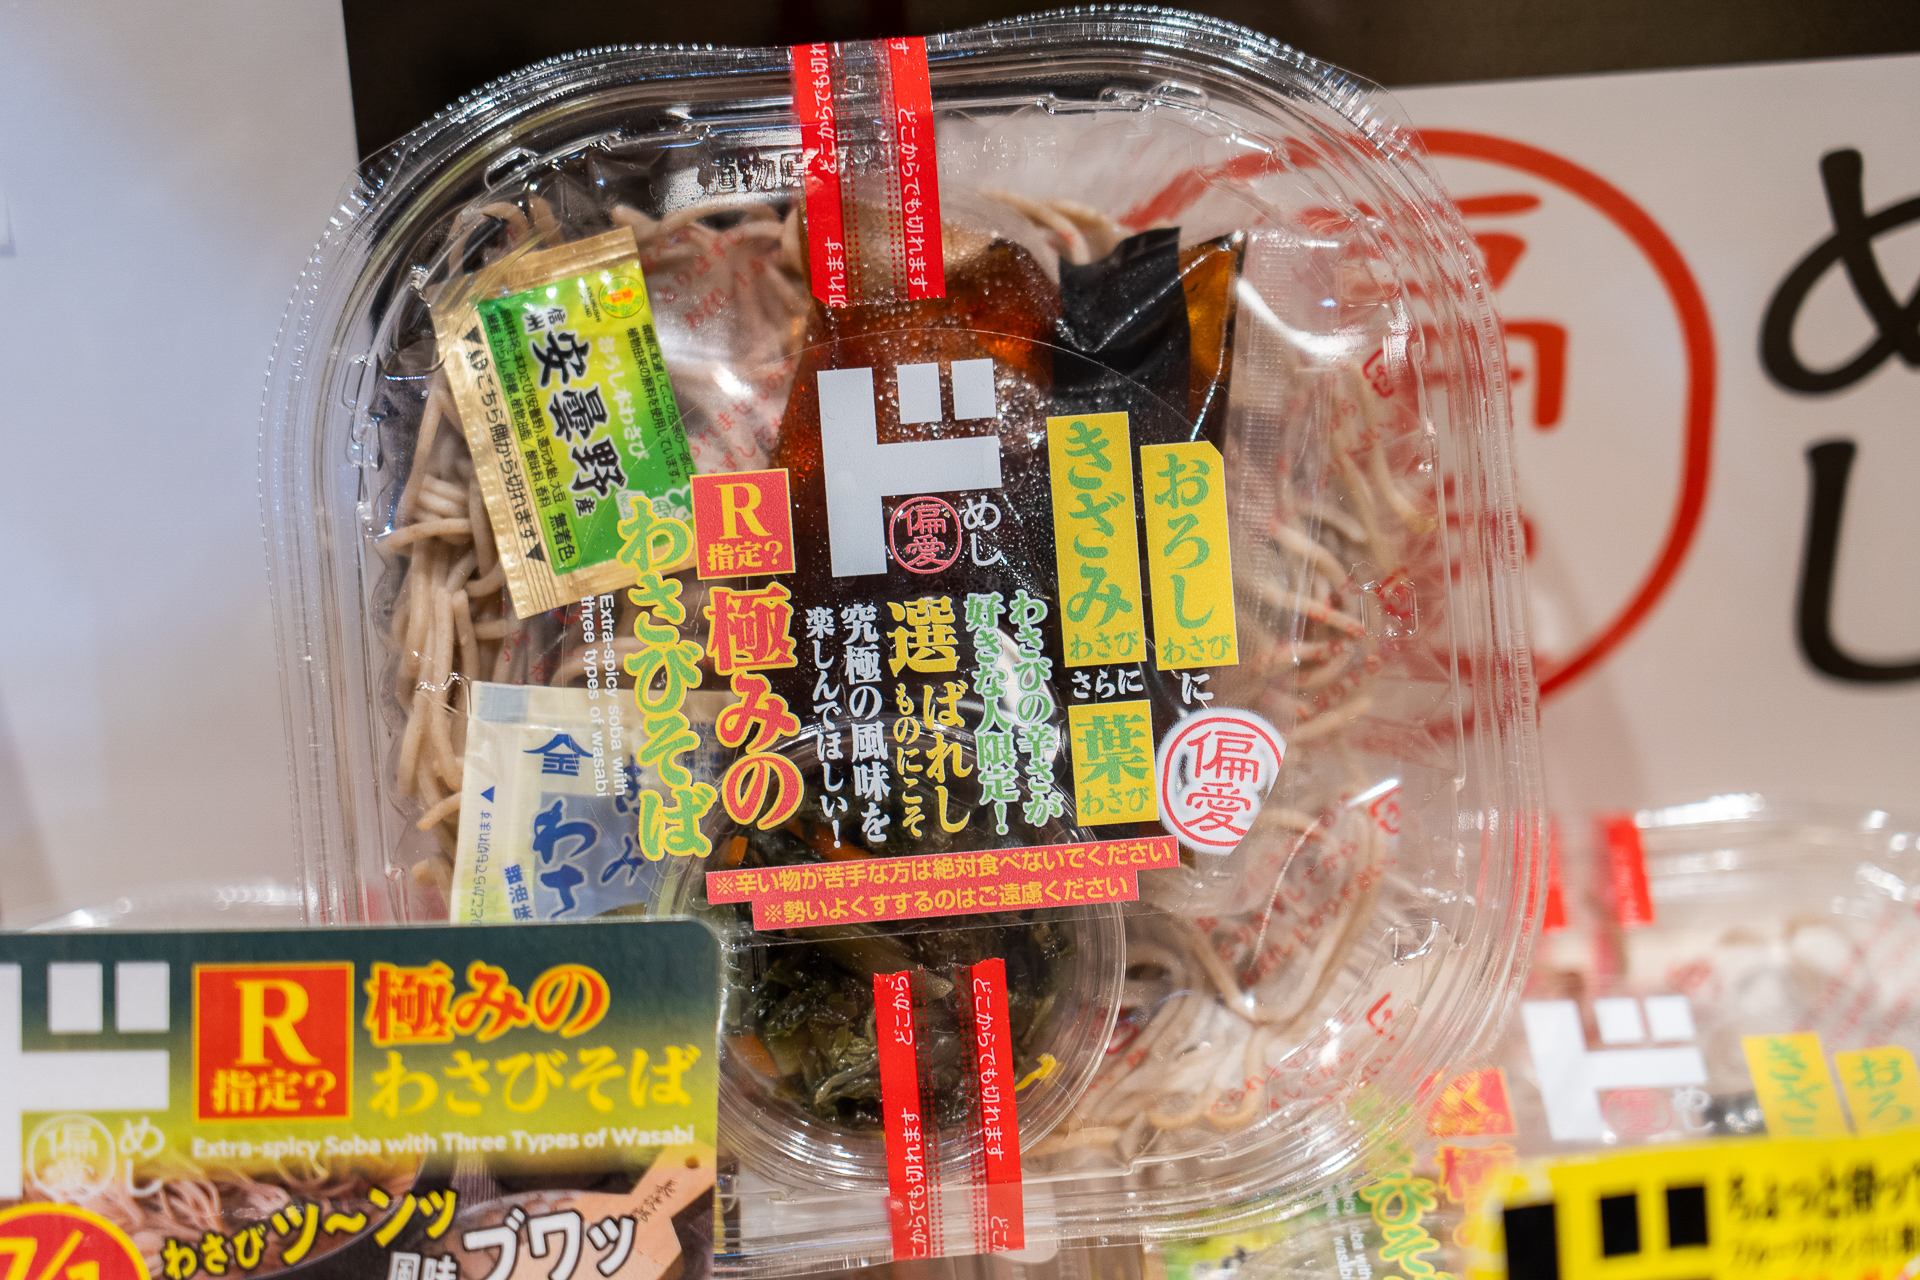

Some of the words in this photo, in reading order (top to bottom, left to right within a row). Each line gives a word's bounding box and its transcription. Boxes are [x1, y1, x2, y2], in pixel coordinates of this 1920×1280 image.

[898, 108, 928, 292] どこからでも切れます
[476, 373, 539, 545] こちら側から切れます
[549, 511, 578, 563] 無着色
[715, 482, 772, 539] R
[899, 502, 952, 569] 偏愛
[963, 496, 1001, 566] めし
[1065, 421, 1133, 629] きざみ
[1154, 453, 1215, 630] おろし
[581, 595, 596, 643] three
[599, 594, 617, 698] Extra-spicy
[1069, 630, 1139, 662] わさび
[1163, 634, 1232, 664] わさび
[584, 649, 599, 700] types
[616, 496, 717, 862] わさびそば
[702, 582, 804, 830] 極みの
[1009, 589, 1065, 827] わさびの辛さが
[1073, 670, 1144, 698] さらに
[1181, 672, 1215, 704] に
[589, 706, 602, 726] of
[608, 705, 622, 750] soba
[841, 604, 891, 843] 究極の風味を
[1076, 714, 1151, 785] 葉
[591, 730, 607, 796] wasabi
[613, 759, 628, 796] with
[1183, 730, 1260, 836] 偏愛
[1081, 787, 1150, 816] わさび
[234, 979, 321, 1066] R
[364, 960, 611, 1047] 極みの
[891, 976, 913, 1045] どこから
[370, 1044, 701, 1118] わさびそば
[974, 978, 1005, 1161] どこからでも切れます
[119, 1117, 165, 1198] めし
[193, 1136, 320, 1159] Extra-spicy
[324, 1135, 381, 1155] Soba
[386, 1133, 437, 1153] with
[442, 1132, 506, 1151] Three
[512, 1130, 579, 1153] Types
[583, 1129, 607, 1148] of
[612, 1126, 694, 1146] Wasabi
